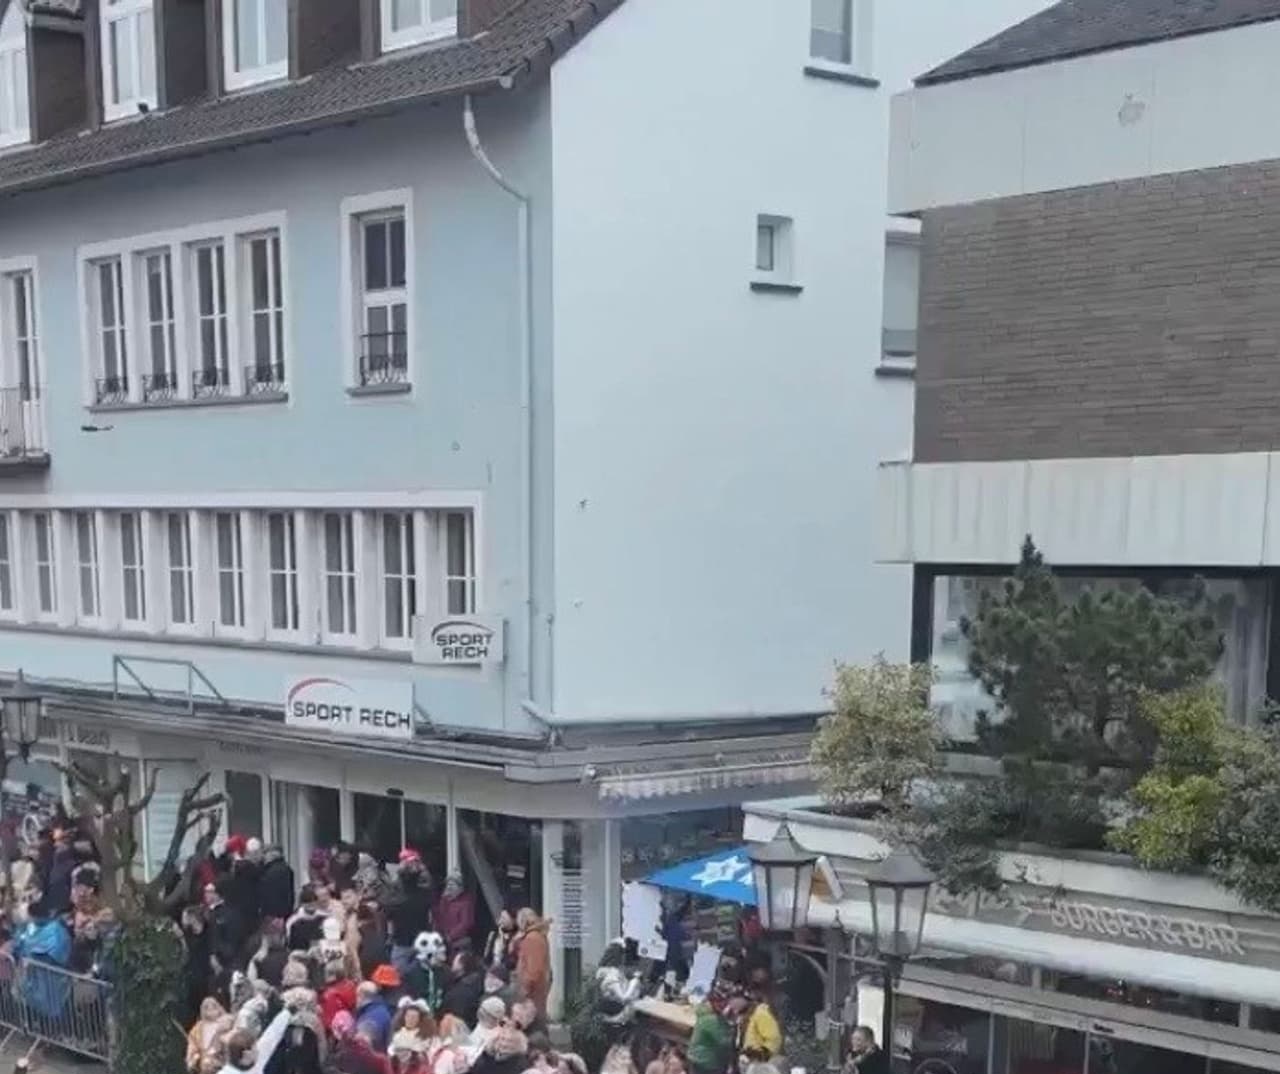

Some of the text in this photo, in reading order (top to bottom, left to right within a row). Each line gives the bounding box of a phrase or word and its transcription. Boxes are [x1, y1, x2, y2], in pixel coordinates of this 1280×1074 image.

[435, 632, 494, 647] SPORT
[441, 646, 489, 661] RECH
[292, 700, 412, 729] SPORT RECH
